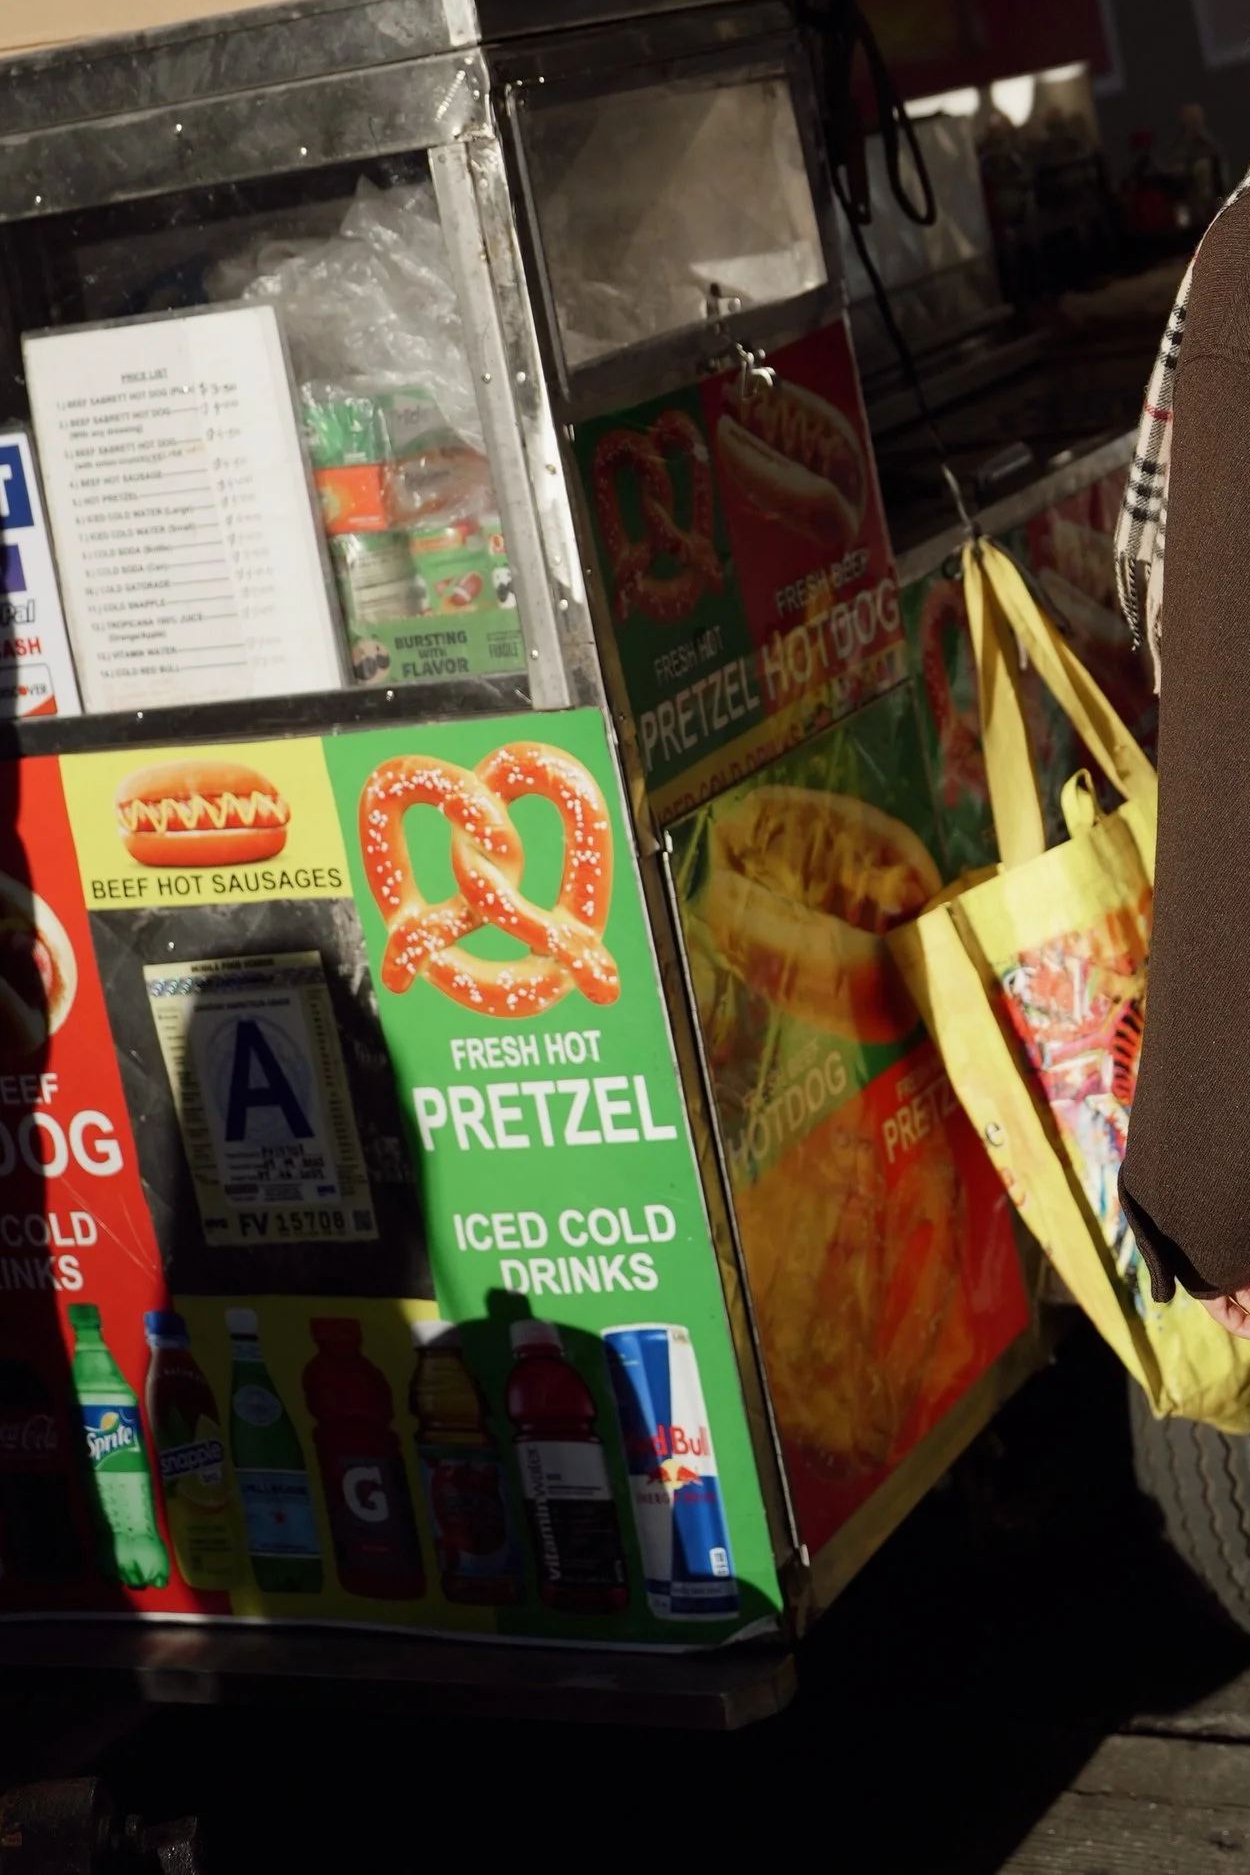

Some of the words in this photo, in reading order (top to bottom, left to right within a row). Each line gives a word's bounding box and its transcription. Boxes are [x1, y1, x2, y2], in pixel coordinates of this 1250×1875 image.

[395, 630, 468, 650] BURSTING
[402, 658, 469, 678] FLAVOR
[654, 642, 697, 685] FRESH
[640, 656, 760, 772] PRETZEL
[91, 875, 149, 900] BEEF
[156, 873, 206, 897] HOT
[211, 867, 344, 895] SAUSAGES
[450, 1036, 539, 1071] FRESH
[544, 1030, 602, 1065] HOT
[225, 1020, 315, 1142] A
[411, 1074, 678, 1151] PRETZEL
[1, 1211, 97, 1247] COLD
[239, 1213, 268, 1236] FV
[452, 1210, 549, 1253] ICED
[558, 1204, 678, 1247] COLD
[499, 1253, 660, 1296] DRINKS
[85, 1424, 135, 1460] Sprite
[159, 1441, 225, 1476] snapple
[341, 1465, 390, 1523] G
